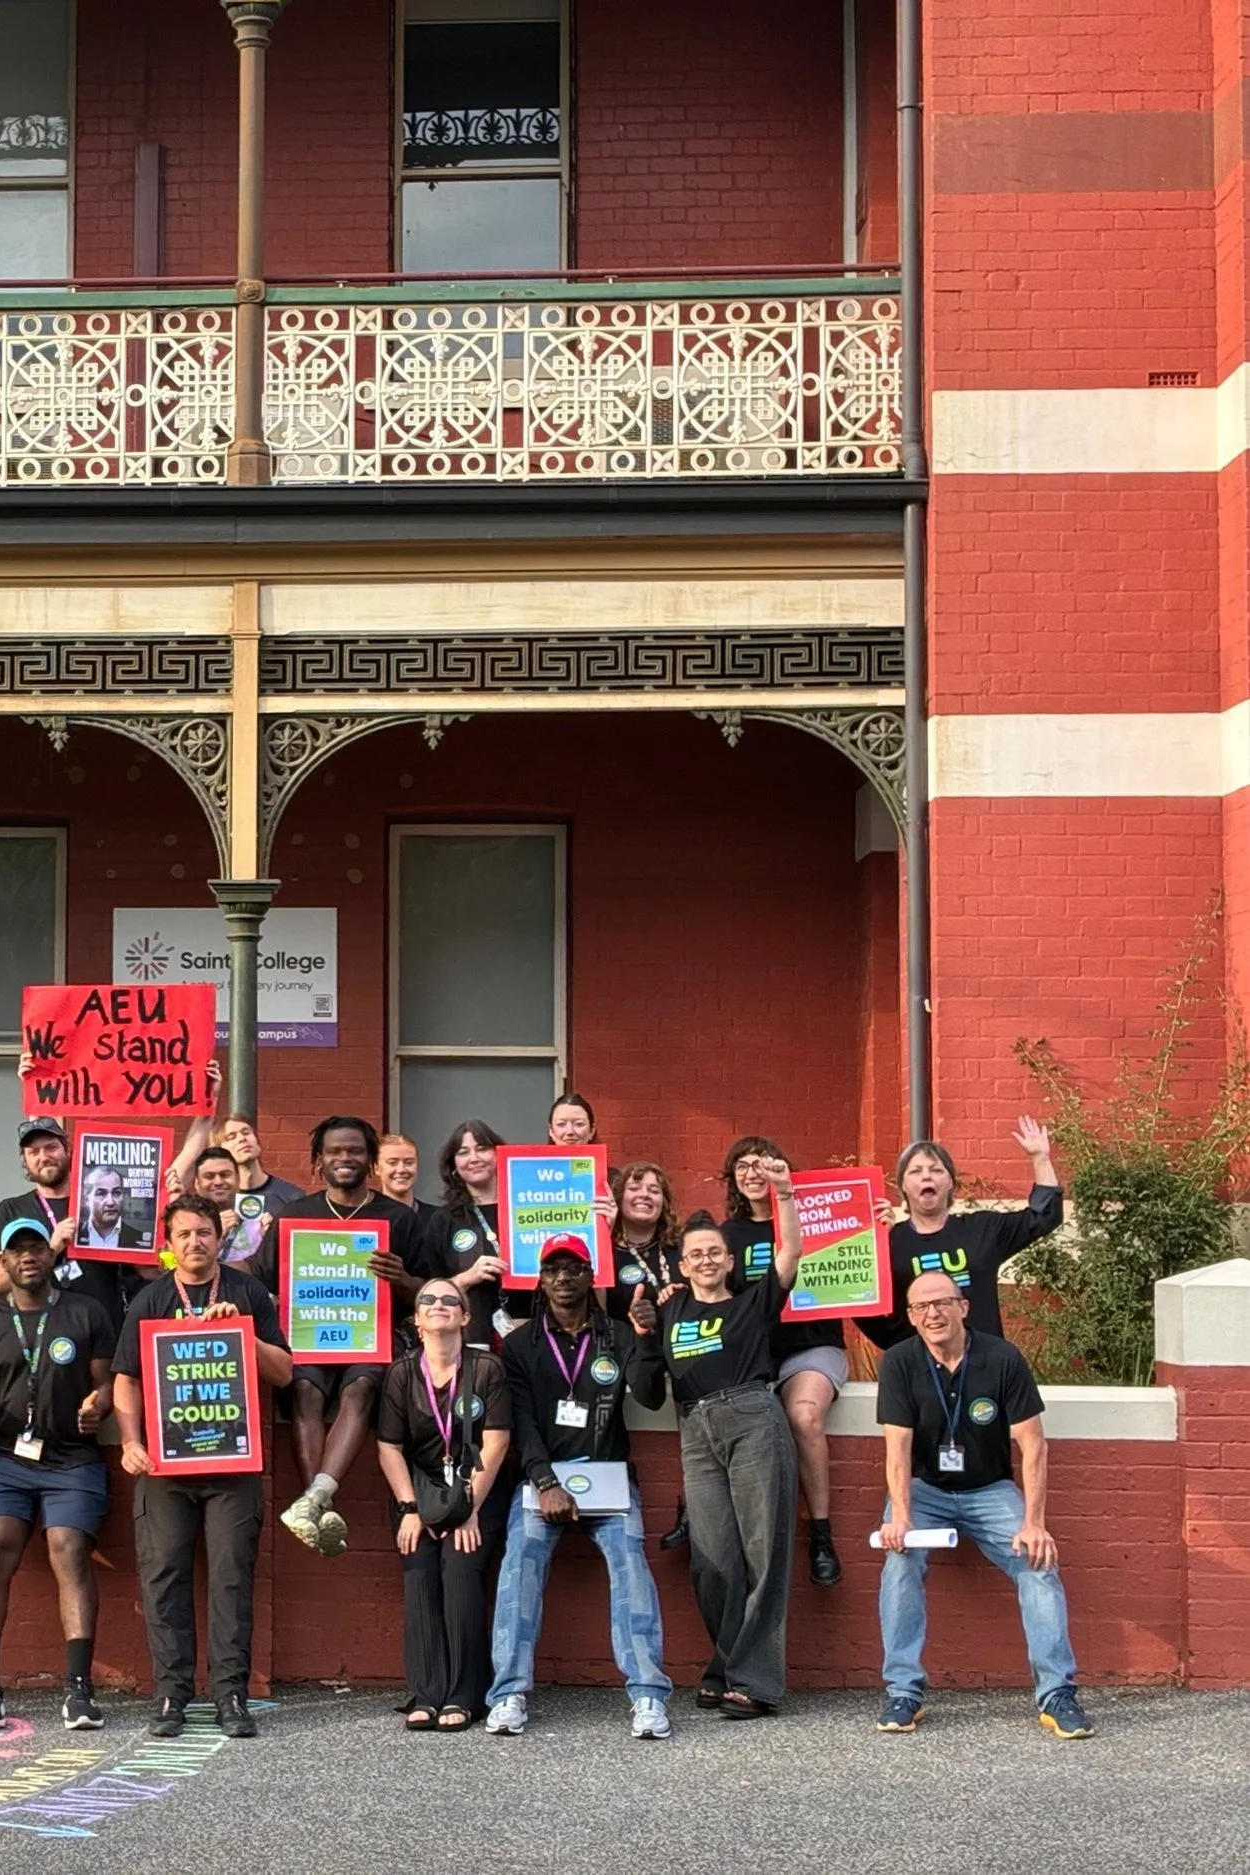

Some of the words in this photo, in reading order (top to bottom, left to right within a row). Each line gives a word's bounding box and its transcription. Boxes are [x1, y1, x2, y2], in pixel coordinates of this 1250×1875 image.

[180, 951, 231, 970] Saint
[274, 980, 313, 993] journey
[74, 988, 167, 1027] AEU
[25, 1020, 67, 1061] We
[258, 1030, 298, 1041] ampus
[86, 1142, 156, 1166] MERLINO:
[128, 1168, 155, 1178] DENYING
[537, 1169, 565, 1182] We
[517, 1190, 566, 1203] stand
[569, 1189, 585, 1202] in
[794, 1189, 853, 1210] LOCKED
[518, 1208, 589, 1225] solidarity
[799, 1207, 832, 1223] ROM
[520, 1229, 550, 1244] wit
[320, 1242, 347, 1256] We
[838, 1245, 872, 1257] STILL
[801, 1258, 872, 1274] STANDING
[911, 1247, 967, 1277] IEU
[299, 1264, 348, 1277] stand
[351, 1264, 367, 1278] in
[803, 1275, 840, 1287] WITH
[842, 1273, 873, 1284] AEU.
[298, 1285, 370, 1302] solidarity
[299, 1306, 337, 1321] with
[339, 1307, 368, 1322] the
[319, 1330, 348, 1343] AEU
[670, 1317, 724, 1343] IEU
[172, 1341, 229, 1360] WE'D
[165, 1361, 238, 1381] STRIKE
[175, 1384, 193, 1402] IF
[196, 1382, 231, 1401] WE
[168, 1404, 241, 1424] COULD
[34, 1748, 109, 1768] NO
